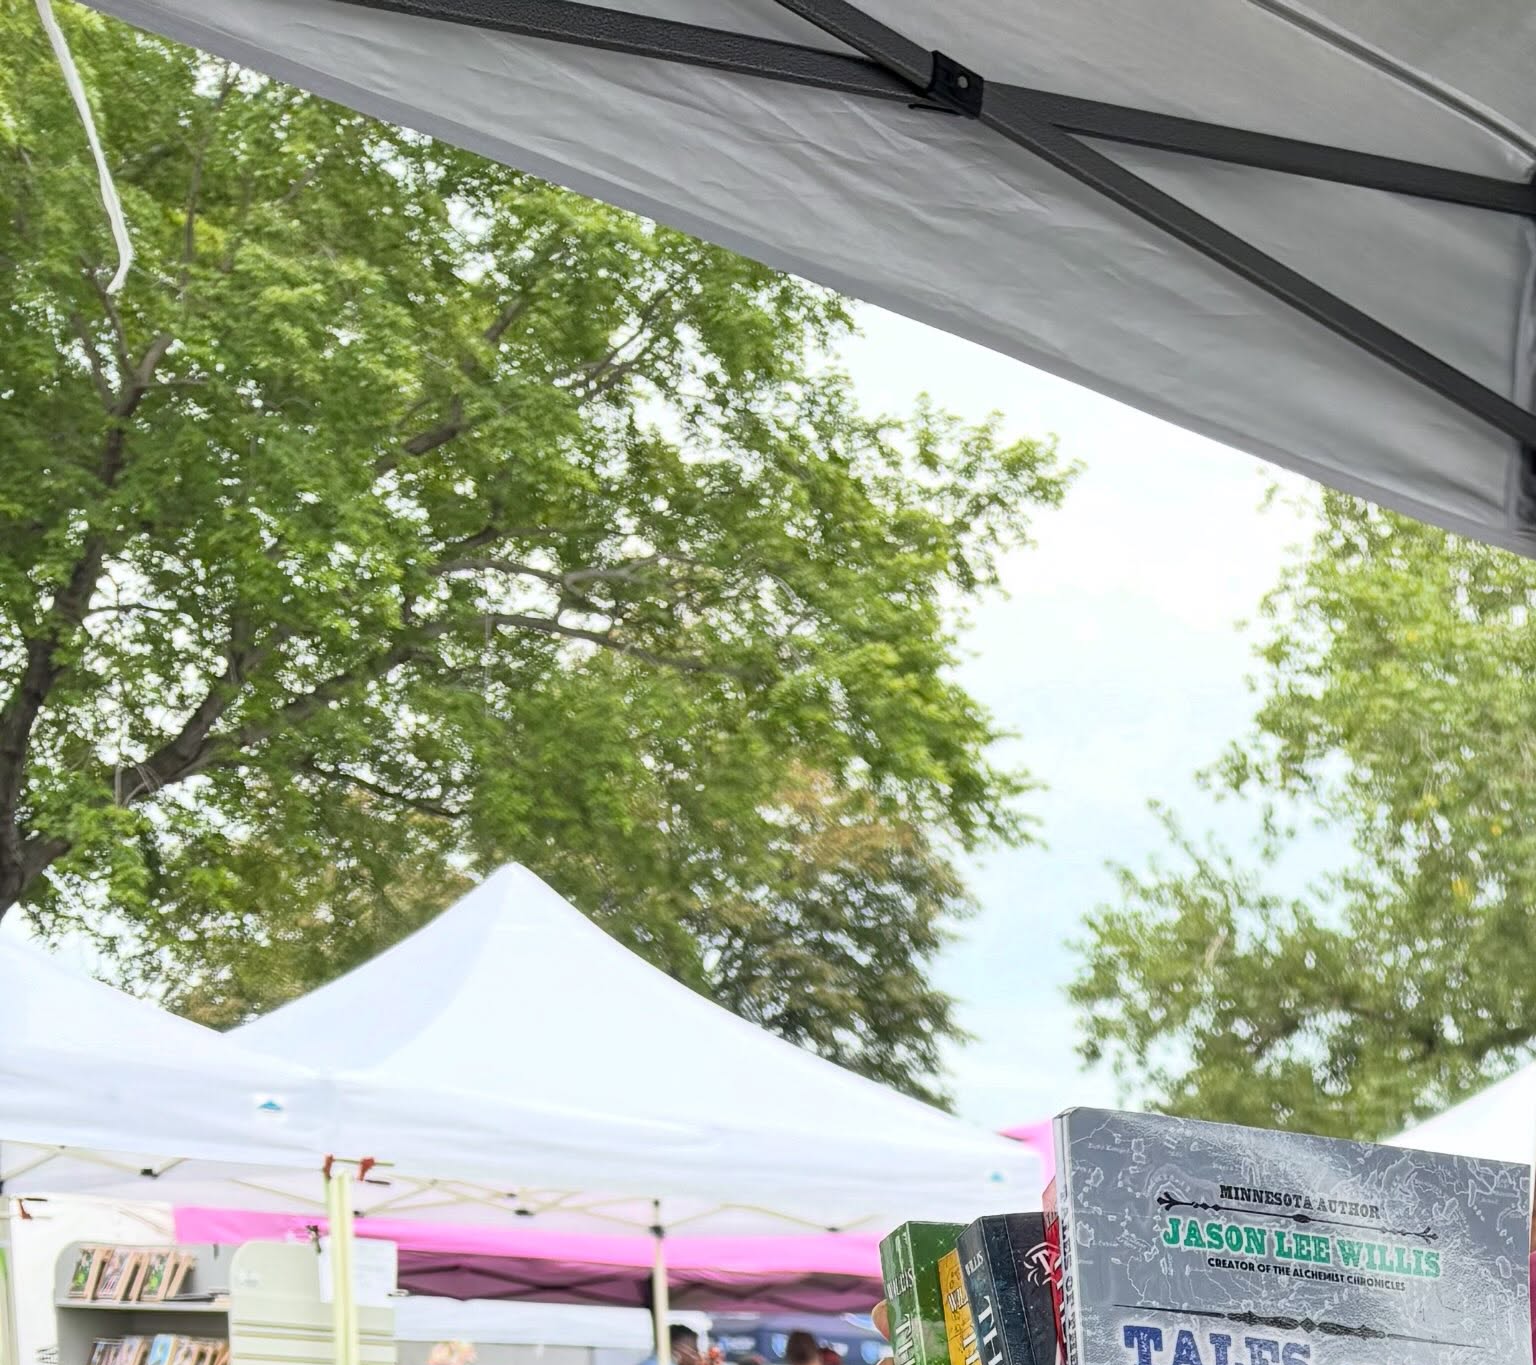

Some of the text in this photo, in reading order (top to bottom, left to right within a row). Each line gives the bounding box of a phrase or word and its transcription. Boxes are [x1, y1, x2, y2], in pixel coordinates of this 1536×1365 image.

[1220, 1185, 1380, 1220] MINNESOTA AUTHOR
[1163, 1217, 1441, 1279] JASON LEE WILLIS
[1207, 1257, 1406, 1292] CREATOR OF THE ALCHEMIST CHRONICLES
